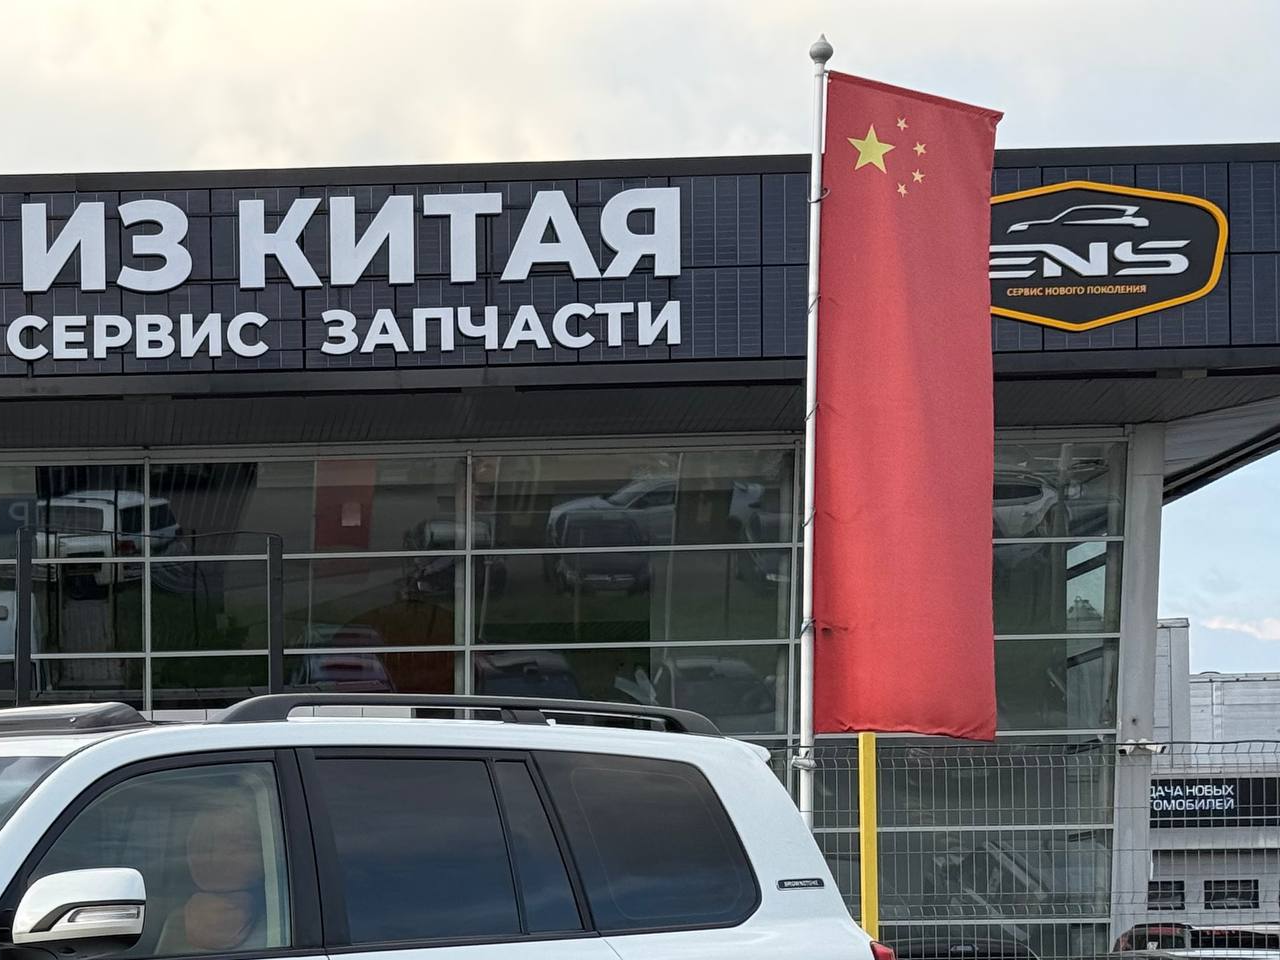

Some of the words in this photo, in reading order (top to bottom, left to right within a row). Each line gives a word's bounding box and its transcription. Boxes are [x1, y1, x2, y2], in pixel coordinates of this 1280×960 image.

[22, 200, 193, 294] ИЗ
[238, 187, 681, 289] КИТАЯ
[989, 240, 1191, 279] ENS
[1006, 287, 1044, 297] СЕРВИС
[1045, 286, 1085, 296] НОВОГО
[1087, 284, 1147, 295] ПОКОЛЕНИЯ
[6, 312, 269, 361] СЕРВИС
[320, 300, 681, 355] ЗАПЧАСТИ
[1186, 784, 1235, 796] НОВЫХ
[1150, 797, 1235, 811] ОМОБИЛЕЙ
